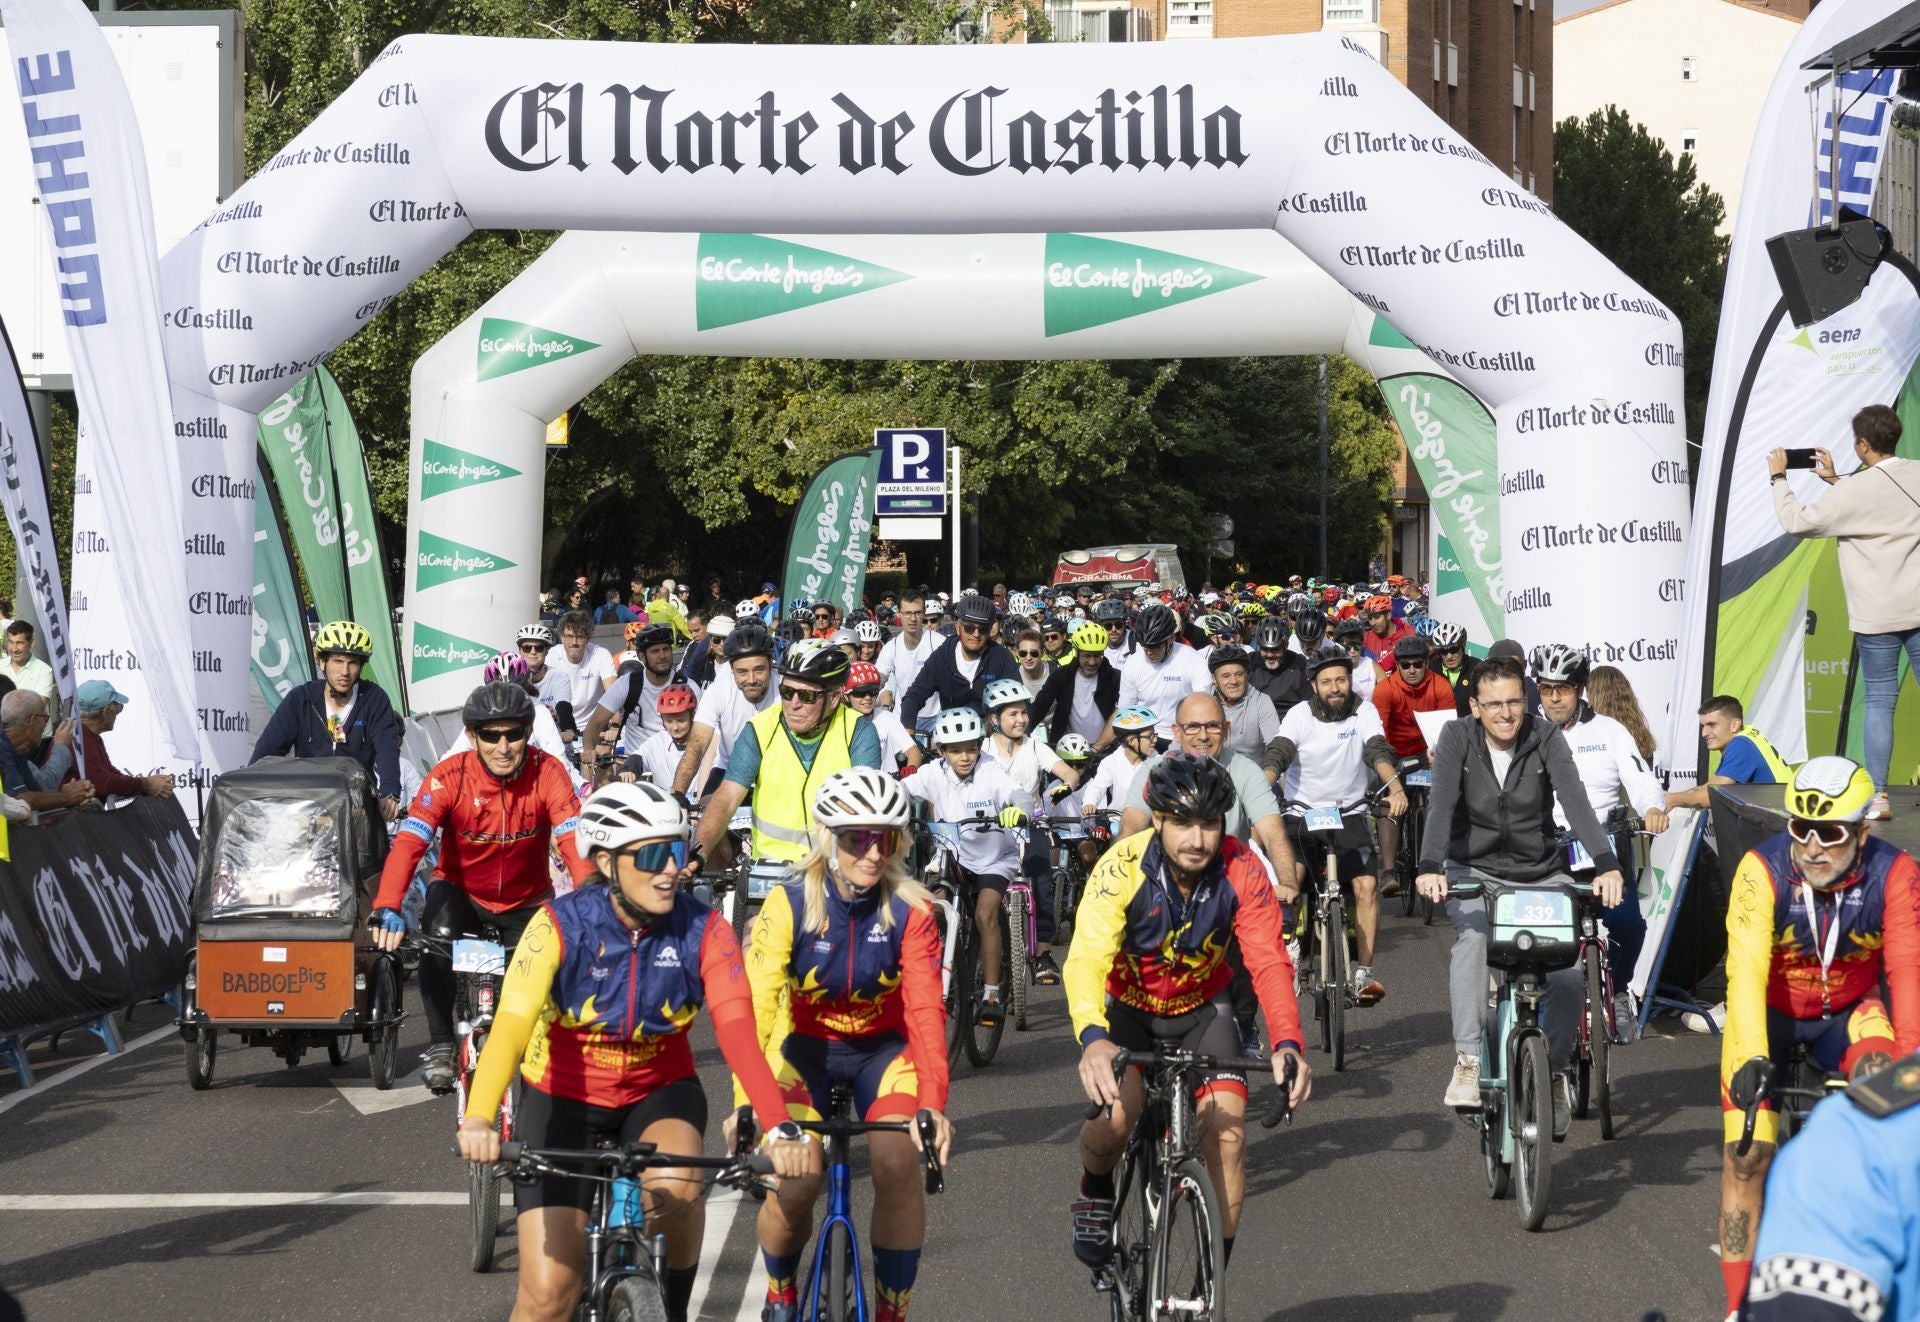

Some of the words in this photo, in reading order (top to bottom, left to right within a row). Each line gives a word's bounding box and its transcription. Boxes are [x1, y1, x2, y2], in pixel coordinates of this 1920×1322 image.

[379, 84, 400, 108] El
[1319, 76, 1358, 97] tilla
[484, 81, 591, 172] El
[600, 83, 820, 176] Norte
[831, 91, 916, 176] de
[928, 83, 1250, 176] Castilla
[313, 145, 333, 164] de
[334, 141, 411, 165] Castilla
[1325, 132, 1351, 156] El
[1353, 131, 1407, 154] Norte
[1409, 133, 1429, 153] de
[1432, 137, 1494, 168] Castilla
[1807, 69, 1895, 229] HLE
[369, 199, 396, 223] El
[399, 199, 451, 222] Norte
[1292, 190, 1368, 214] Castilla
[1482, 187, 1505, 207] El
[1505, 190, 1549, 217] Norte
[217, 251, 242, 275] El
[245, 252, 299, 276] Norte
[302, 255, 323, 277] de
[326, 255, 401, 278] Castilla
[1340, 244, 1364, 267] El
[1364, 244, 1418, 268] Norte
[1420, 244, 1442, 265] de
[1445, 237, 1526, 264] Castilla
[701, 256, 724, 281] El
[726, 258, 780, 284] Corte
[784, 255, 864, 294] Inglés
[1049, 262, 1073, 288] El
[1074, 264, 1130, 288] Corte
[1132, 258, 1213, 298] Inglés
[173, 306, 254, 331] Castilla
[1494, 293, 1521, 317] El
[1524, 291, 1578, 315] Norte
[1580, 291, 1600, 311] de
[1603, 292, 1669, 322] Castilla
[481, 338, 494, 353] El
[494, 338, 527, 353] Corte
[527, 334, 574, 358] Inglés
[1818, 327, 1862, 344] aena
[1441, 348, 1461, 368] de
[1463, 350, 1537, 372] Castilla
[1645, 343, 1664, 366] El
[209, 364, 235, 387] El
[239, 363, 288, 385] Norte
[290, 359, 306, 374] de
[174, 416, 228, 439] astilla
[1516, 408, 1535, 434] El
[1537, 404, 1587, 431] Norte
[1590, 403, 1611, 425] de
[1614, 400, 1676, 425] Castilla
[892, 433, 930, 480] P
[424, 460, 433, 475] El
[432, 461, 458, 475] Corte
[459, 458, 500, 480] Inglés
[1651, 461, 1670, 484] El
[191, 474, 215, 498] El
[218, 475, 251, 500] Norte
[880, 485, 900, 493] PLAZA
[901, 485, 913, 493] DEL
[914, 484, 941, 493] MILENIO
[796, 480, 844, 575] Inglés
[1521, 527, 1540, 551] El
[1543, 523, 1594, 549] Norte
[1597, 522, 1618, 544] de
[1621, 519, 1682, 543] Castilla
[184, 534, 226, 556] stilla
[418, 552, 427, 566] El
[427, 553, 452, 567] Corte
[453, 550, 495, 571] Inglés
[841, 564, 859, 615] orte
[1658, 579, 1678, 602] El
[189, 591, 212, 615] El
[215, 592, 247, 615] Norte
[84, 648, 122, 671] Norte
[193, 651, 222, 673] tilla
[414, 644, 422, 658] El
[422, 645, 447, 658] Corte
[447, 642, 489, 664] Inglés
[1604, 641, 1626, 664] de
[212, 709, 244, 732] Norte
[1577, 743, 1608, 754] MAHLE
[1411, 775, 1427, 783] 998
[966, 799, 994, 809] MAHLE
[1313, 816, 1335, 826] 990
[460, 827, 542, 843] ASTANA
[33, 866, 101, 982] El
[1524, 906, 1554, 920] 339
[222, 972, 302, 994] BABBOE
[299, 966, 327, 991] Big
